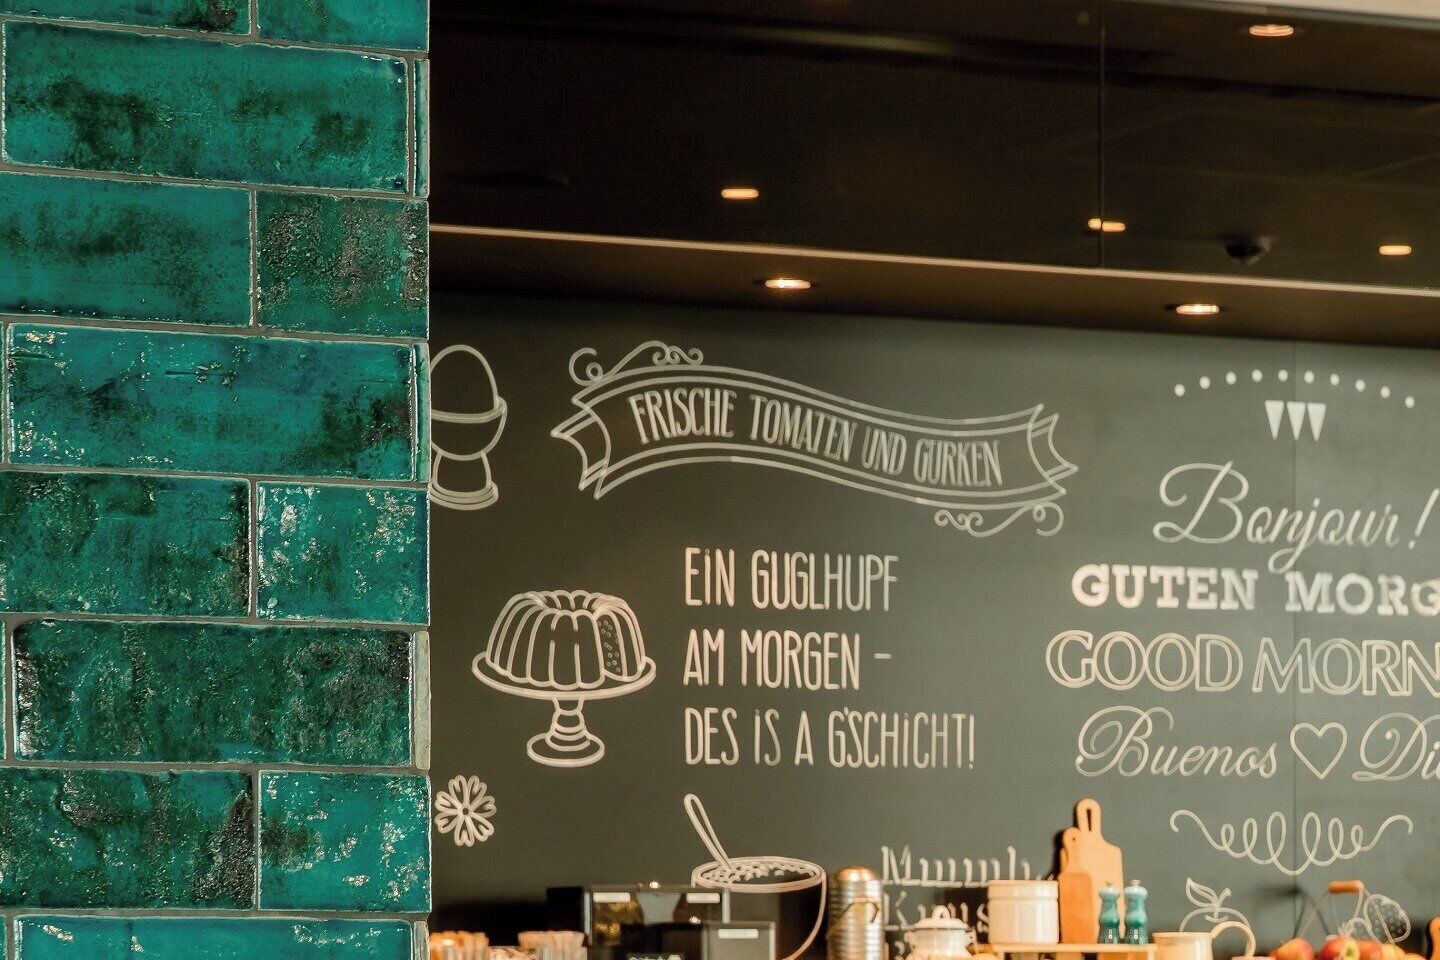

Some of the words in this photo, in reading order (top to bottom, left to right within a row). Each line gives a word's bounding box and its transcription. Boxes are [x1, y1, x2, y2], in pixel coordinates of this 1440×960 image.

[627, 386, 737, 445] FRISCHE
[749, 394, 859, 463] TOMATEN
[861, 427, 907, 476] UND
[912, 438, 1003, 486] GURKEN
[751, 549, 899, 612] GUGLHUPF
[1072, 564, 1258, 611] GUTEN
[683, 628, 725, 686] AM
[741, 629, 860, 690] MORGEN
[1046, 630, 1243, 692] GOOD
[684, 707, 740, 766] DES
[794, 710, 814, 766] A
[1075, 706, 1278, 778] Buenos
